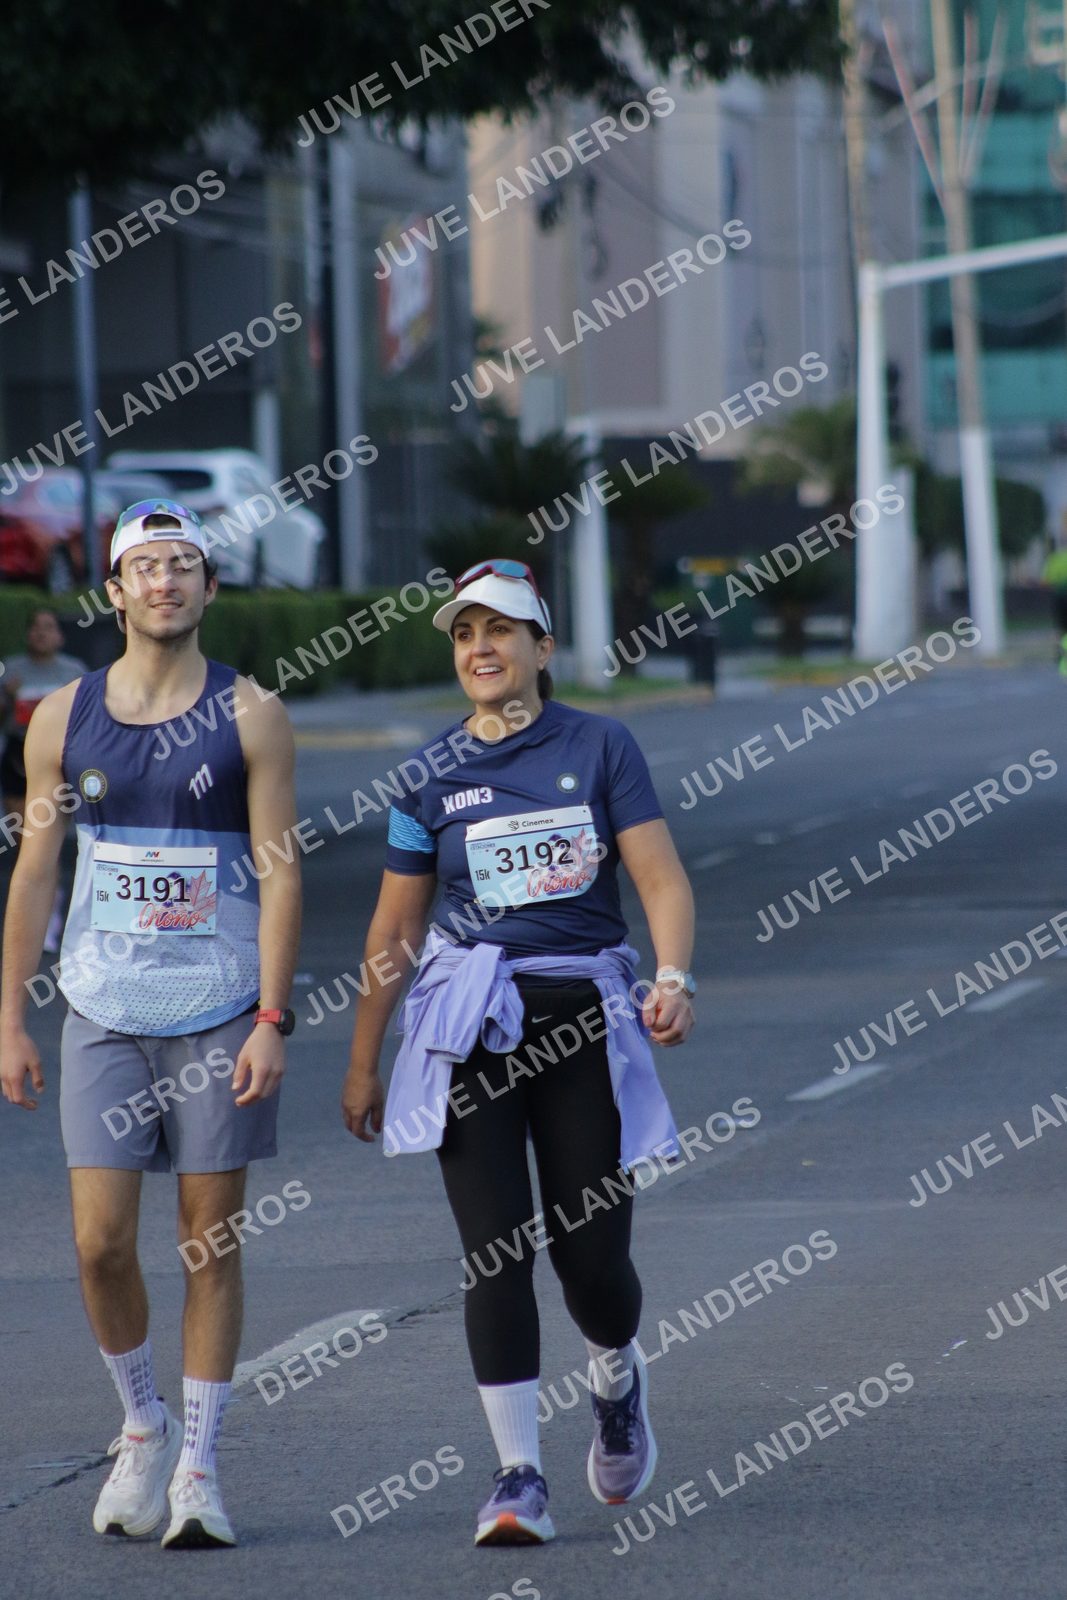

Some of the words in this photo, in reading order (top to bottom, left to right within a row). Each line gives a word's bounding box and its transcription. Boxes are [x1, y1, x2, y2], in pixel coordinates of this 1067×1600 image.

[522, 818, 554, 828] Cinemex
[494, 839, 574, 874] 3192
[115, 874, 191, 903] 3191
